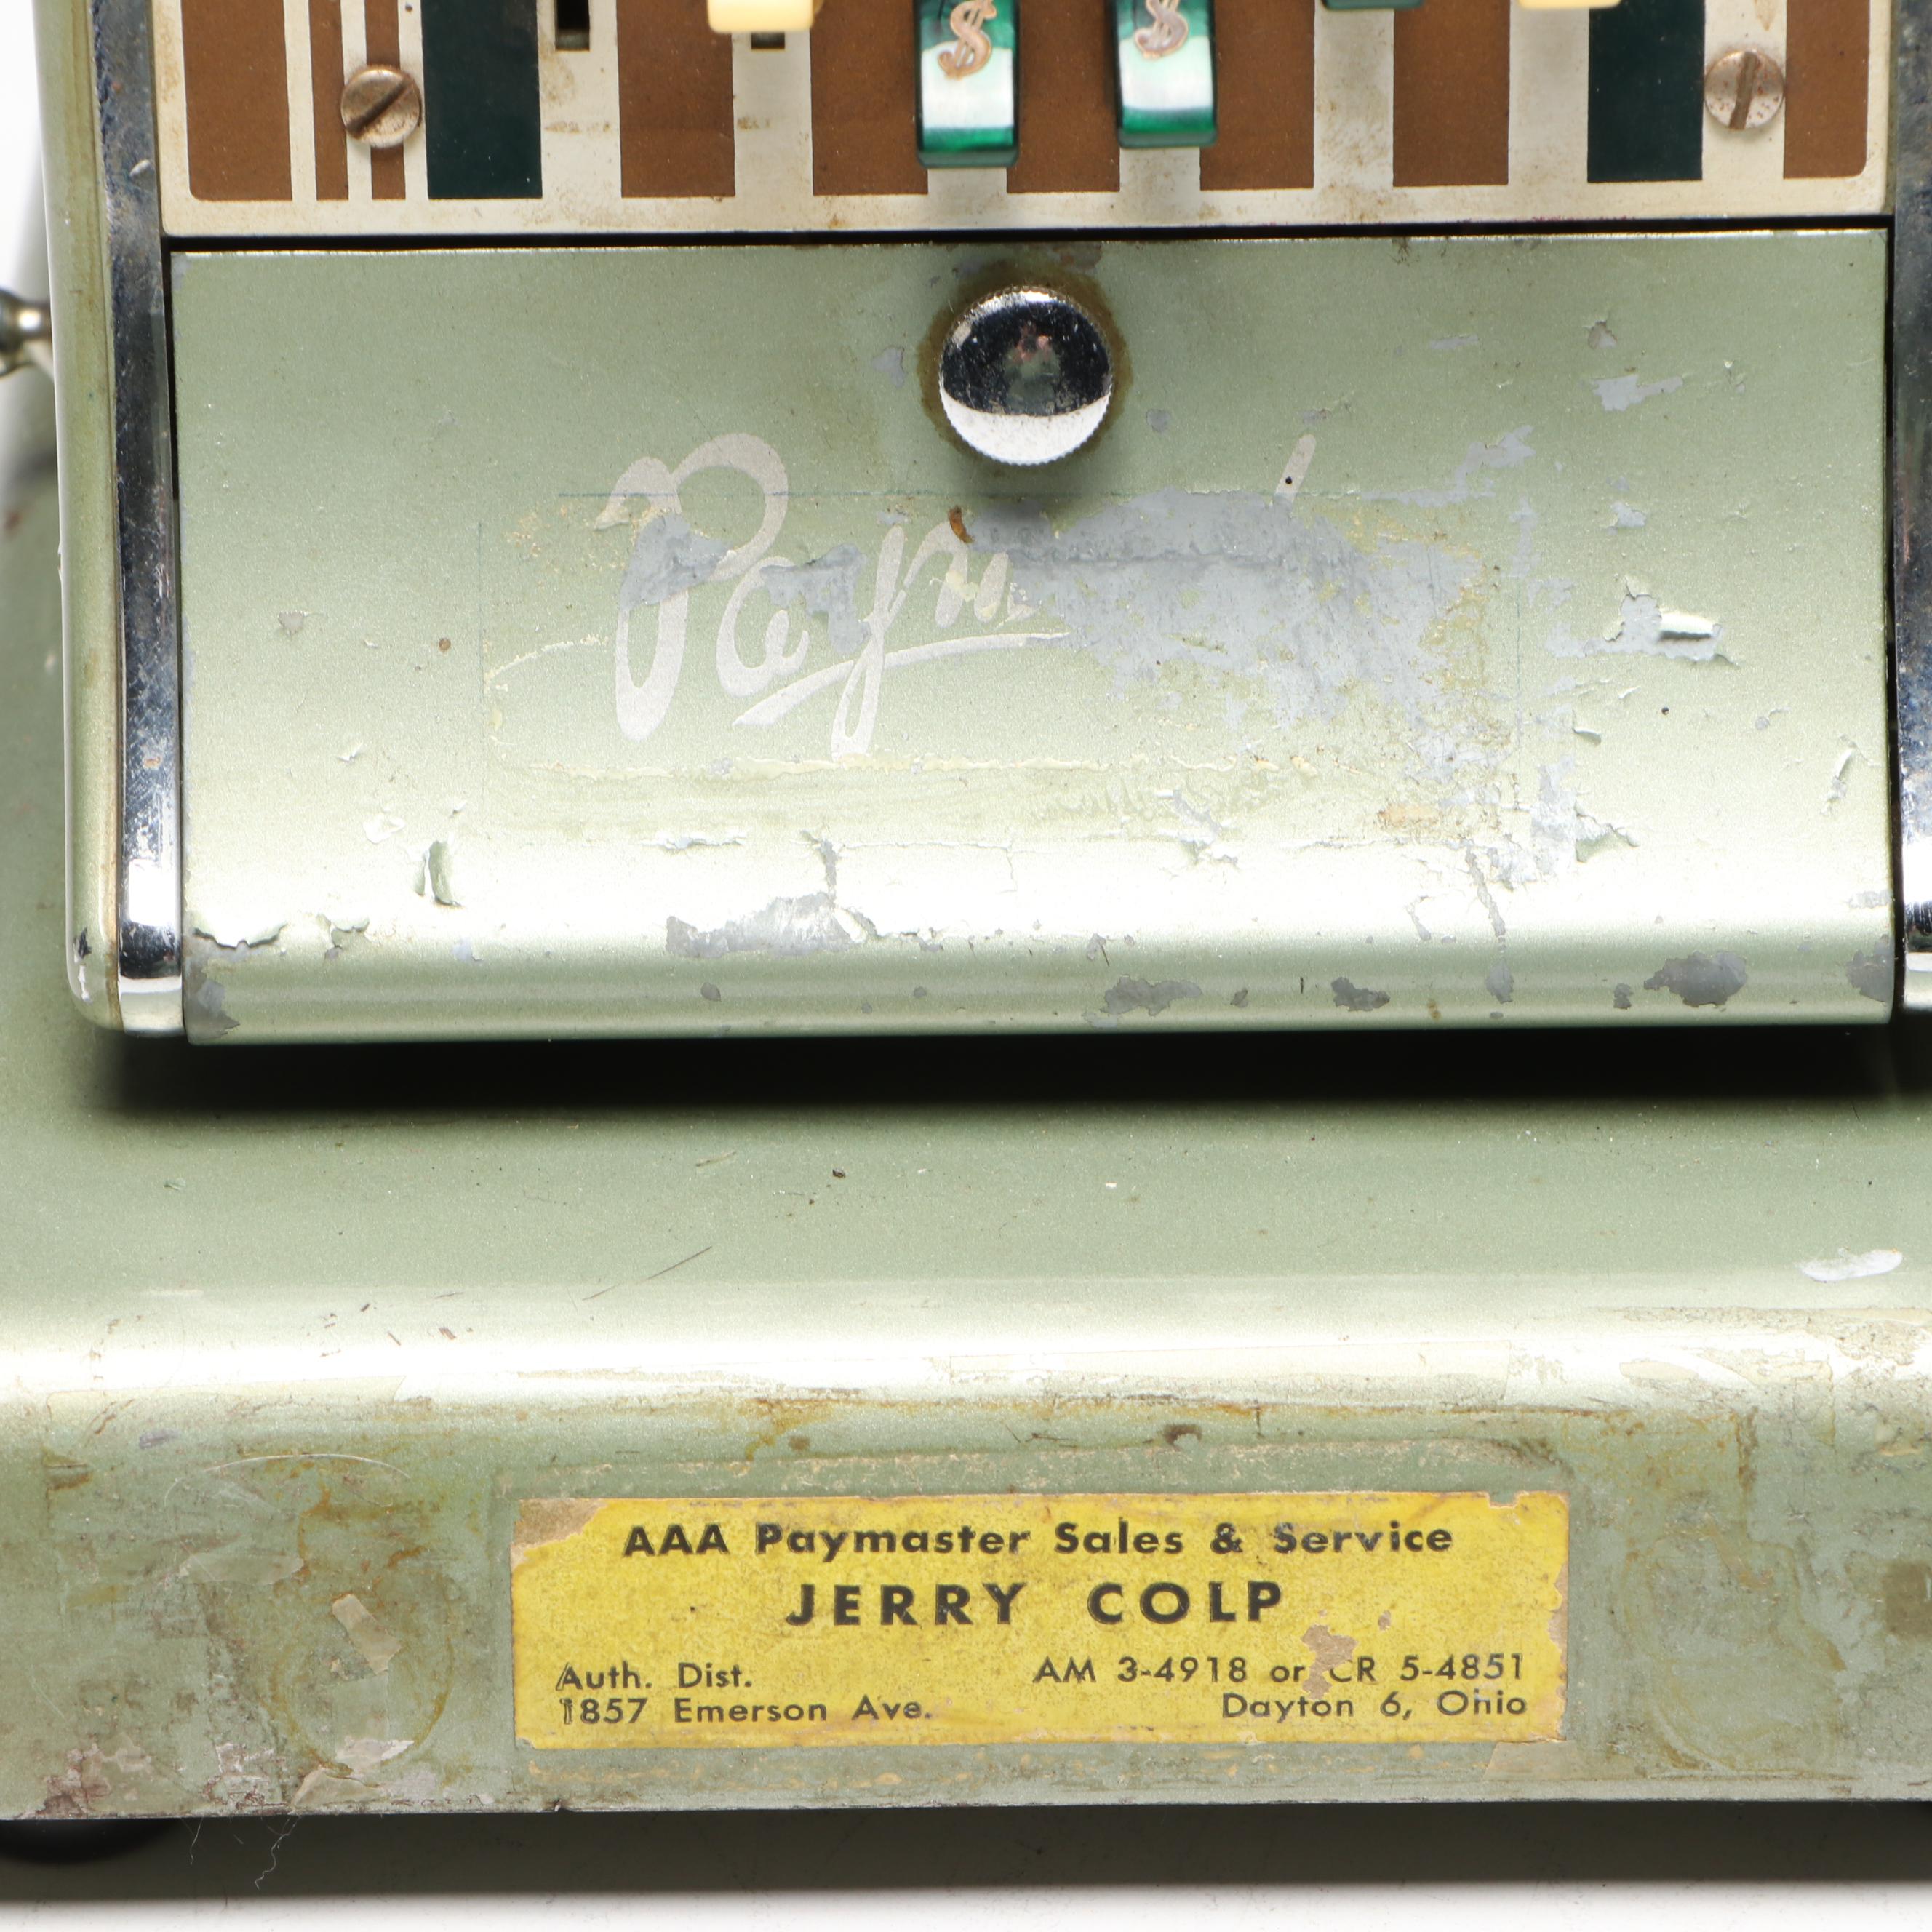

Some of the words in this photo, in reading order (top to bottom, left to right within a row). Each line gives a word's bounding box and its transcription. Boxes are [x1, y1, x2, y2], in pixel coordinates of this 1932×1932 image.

[623, 1523, 729, 1557] AAA
[756, 1522, 1031, 1562] Paymaster
[1055, 1518, 1183, 1554] Sales
[1210, 1522, 1244, 1554] &
[1274, 1520, 1453, 1554] Service
[785, 1582, 1026, 1626] JERRY
[1087, 1581, 1282, 1625] COLP
[555, 1660, 652, 1691] Auth.
[678, 1662, 752, 1688] Dist.
[1033, 1657, 1096, 1683] AM
[1117, 1656, 1247, 1682] 3-4918
[1270, 1666, 1306, 1682] or
[1330, 1656, 1376, 1682] CR
[1400, 1653, 1522, 1680] 5-4851
[559, 1698, 647, 1724] 1857
[674, 1697, 827, 1723] Emerson
[853, 1695, 933, 1720] Ave.
[1222, 1692, 1354, 1722] Dayton
[1380, 1691, 1411, 1719] 6,
[1437, 1688, 1528, 1715] Ohio
